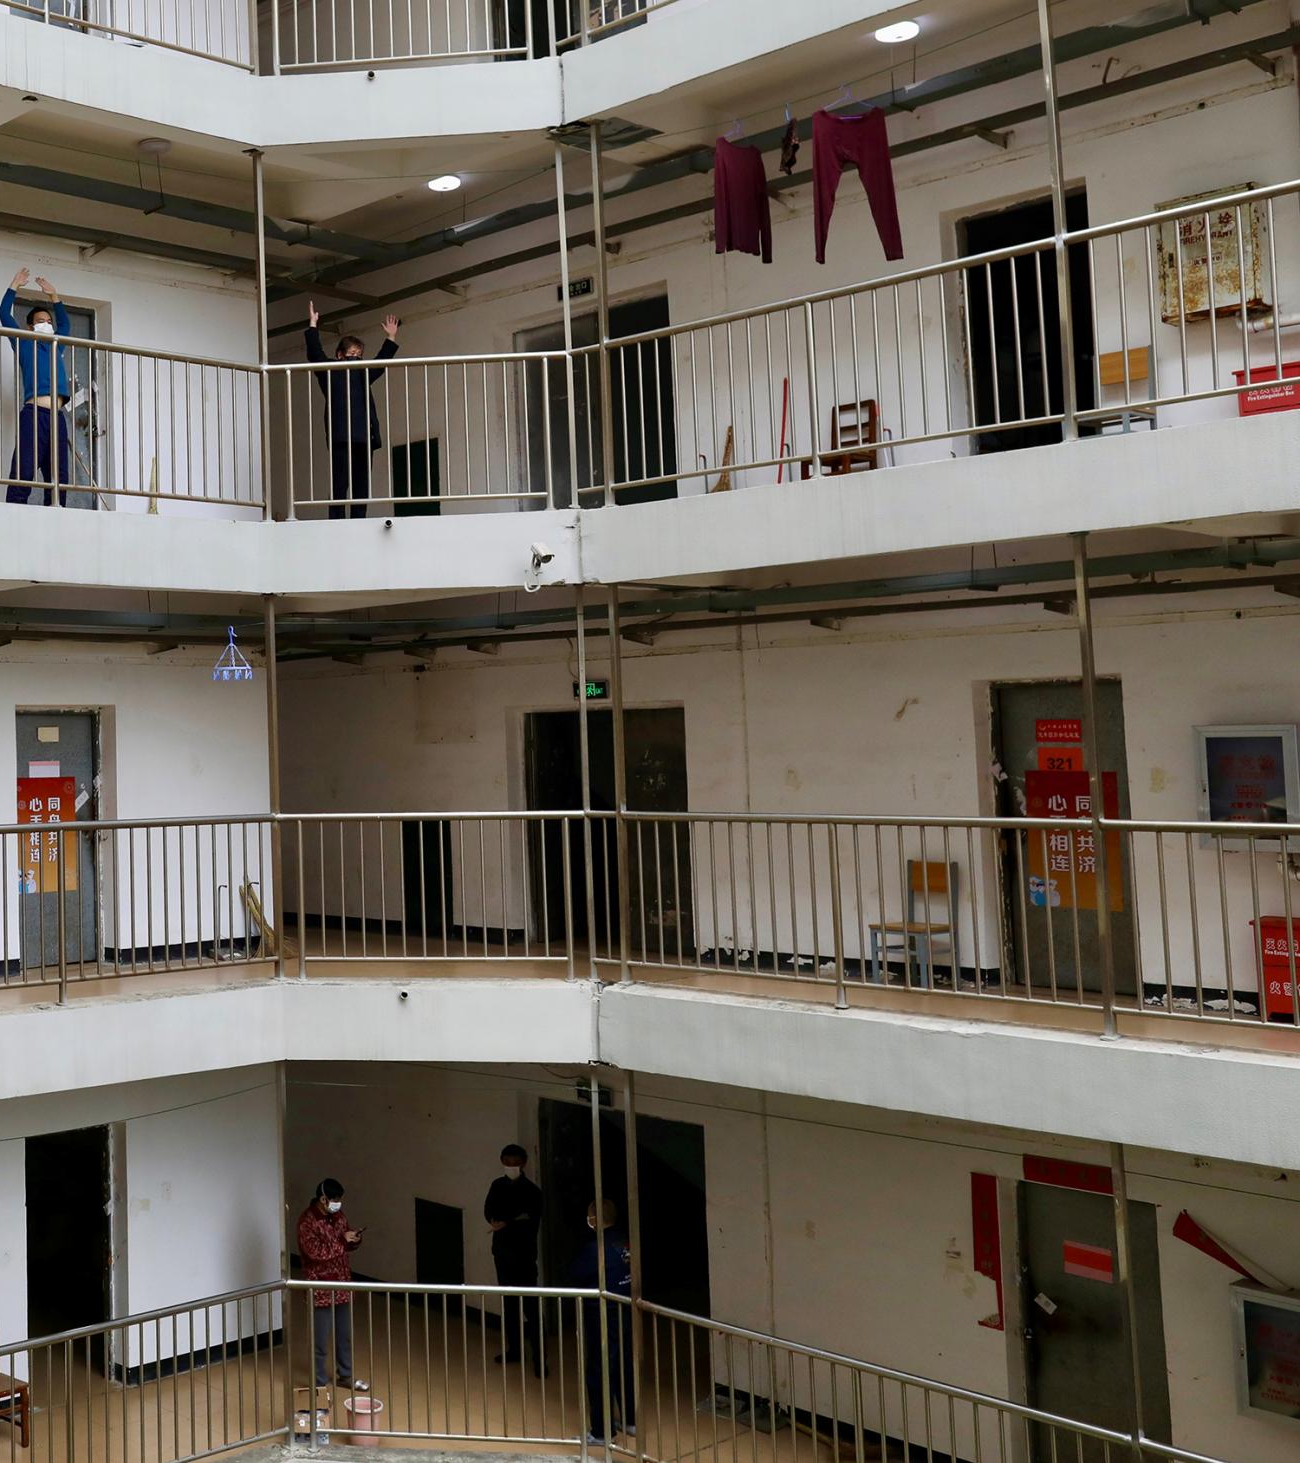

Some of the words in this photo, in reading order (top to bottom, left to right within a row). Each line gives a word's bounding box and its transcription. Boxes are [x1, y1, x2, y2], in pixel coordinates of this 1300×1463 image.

[1047, 758, 1073, 771] 321
[1047, 794, 1070, 872] 心相连
